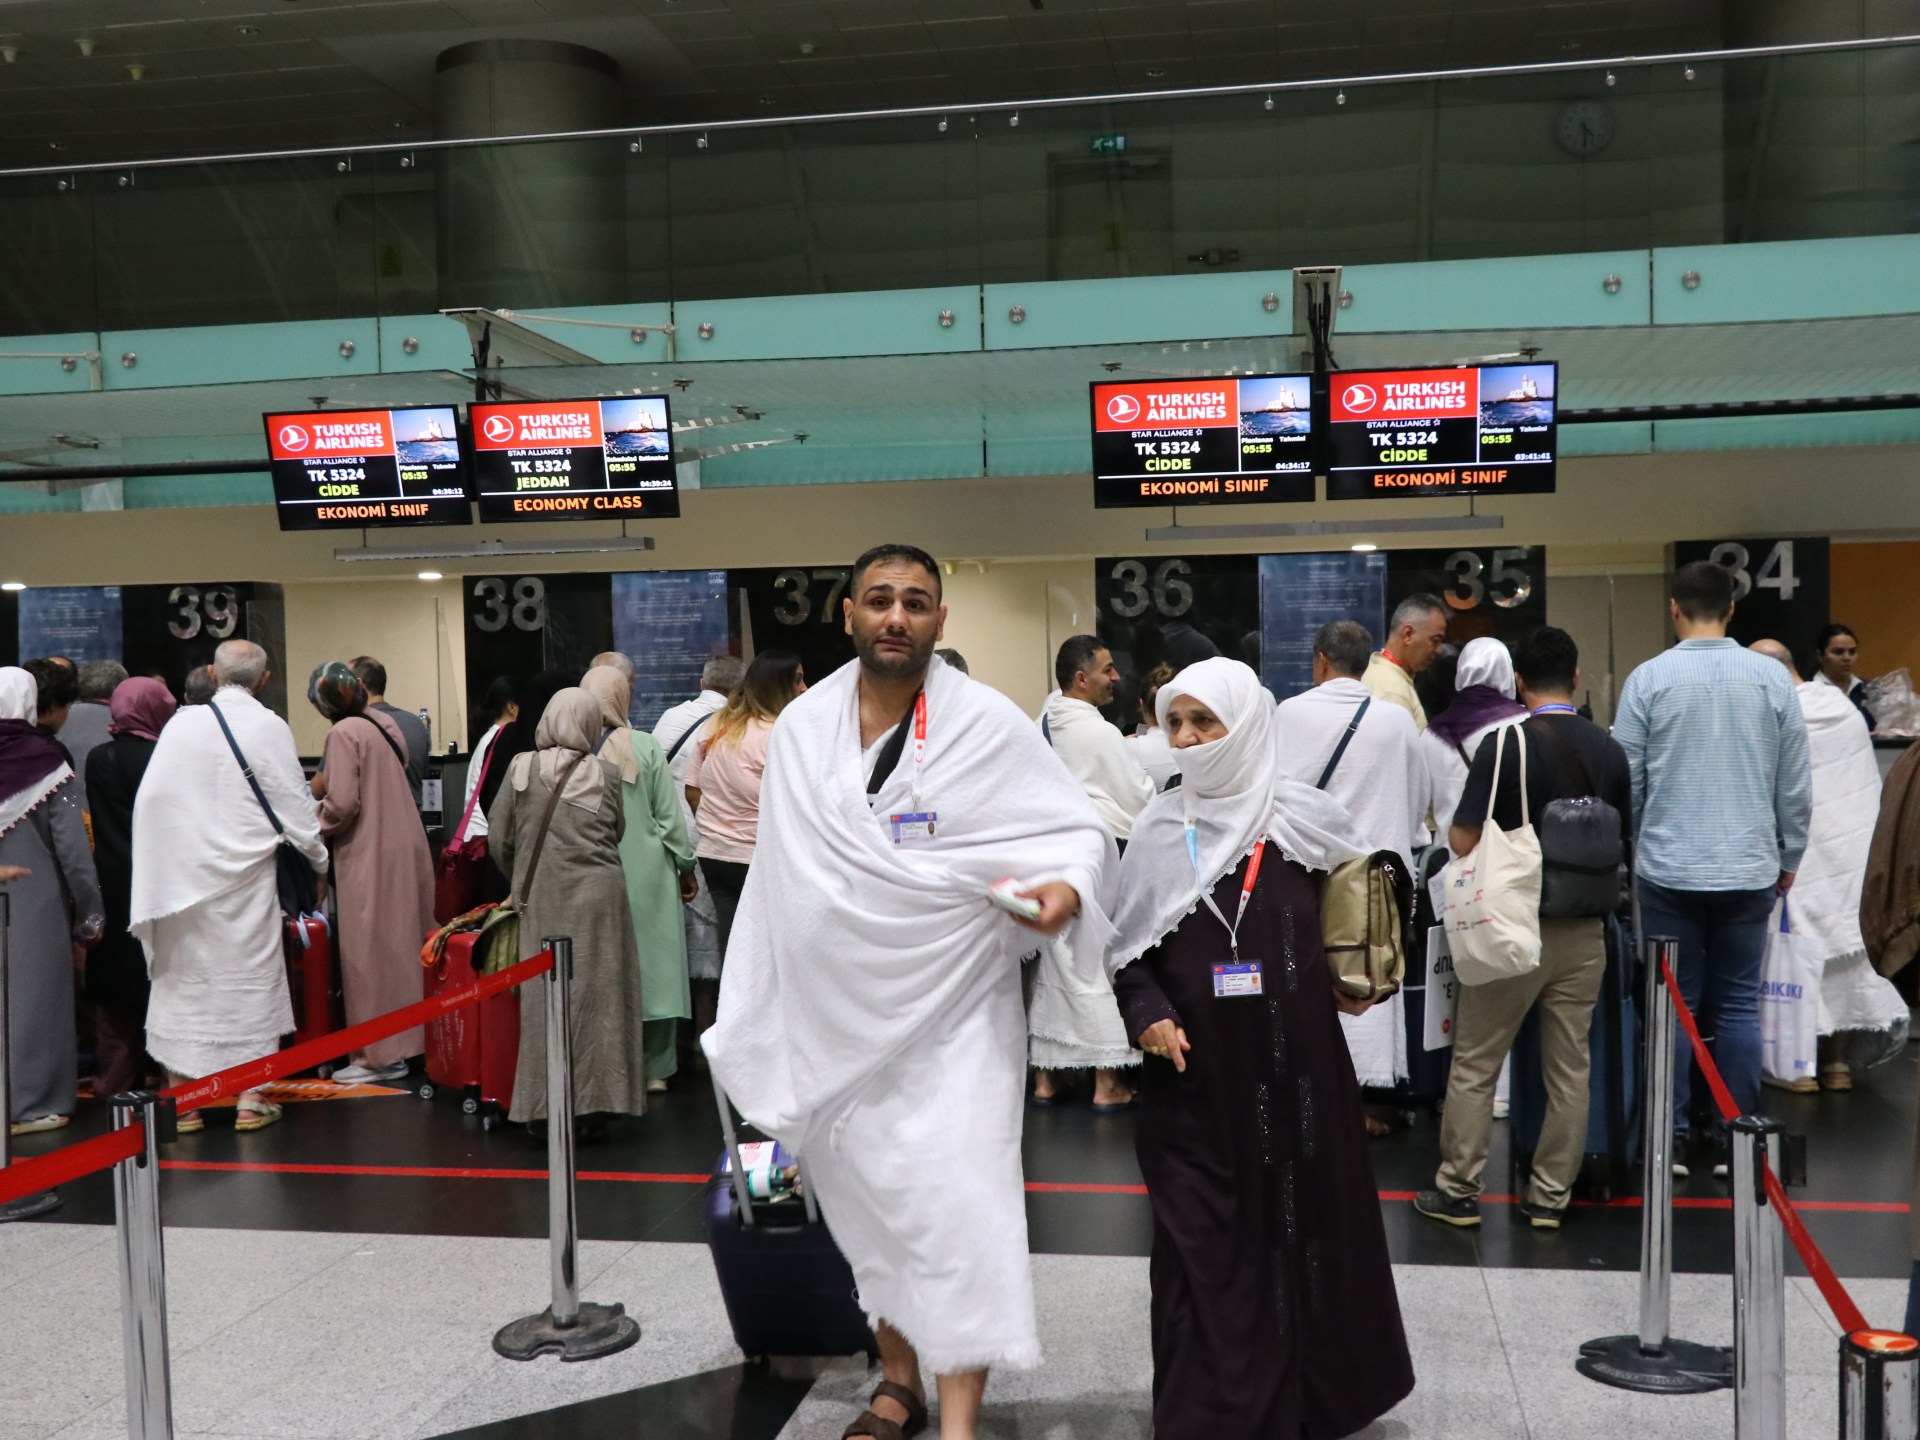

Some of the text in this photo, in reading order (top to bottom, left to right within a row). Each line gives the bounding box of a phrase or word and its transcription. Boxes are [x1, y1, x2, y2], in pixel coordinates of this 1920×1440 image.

[1384, 382, 1465, 396] TURKISH
[1147, 392, 1226, 407] TURKISH
[1382, 395, 1466, 411] AIRLINES
[518, 413, 589, 427] TURKISH
[1147, 406, 1226, 421] AIRLINES
[312, 422, 382, 437] TURKISH
[1366, 419, 1431, 429] STAR ALLIANCE
[520, 426, 592, 440] AIRLINES
[1369, 431, 1438, 446] TK 5324
[1481, 435, 1512, 444] 05:55
[314, 436, 384, 450] AIRLINES
[1135, 441, 1200, 455] TK 5324
[1242, 444, 1272, 453] 05:55
[304, 457, 358, 466] STAR ALLIANCE
[1380, 448, 1427, 463] CİDDE
[511, 460, 571, 473] TK 5324
[609, 463, 636, 472] 05:55
[1145, 457, 1192, 472] CİDDE
[307, 469, 365, 482] TK 5324
[402, 472, 428, 480] 05:55
[517, 476, 570, 490] JEDDAH
[1374, 470, 1507, 488] EKONOMİ SINIF
[319, 483, 359, 496] CİDDE
[1141, 478, 1269, 496] EKONOMİ SINIF
[317, 503, 429, 519] EKONOMİ SINIF
[514, 496, 642, 512] ECONOMY CLASS
[1444, 548, 1532, 610] 35
[1110, 558, 1194, 618] 36
[473, 576, 545, 632] 38
[773, 570, 851, 626] 37
[167, 585, 238, 640] 39
[1759, 981, 1803, 999] AIKIKI
